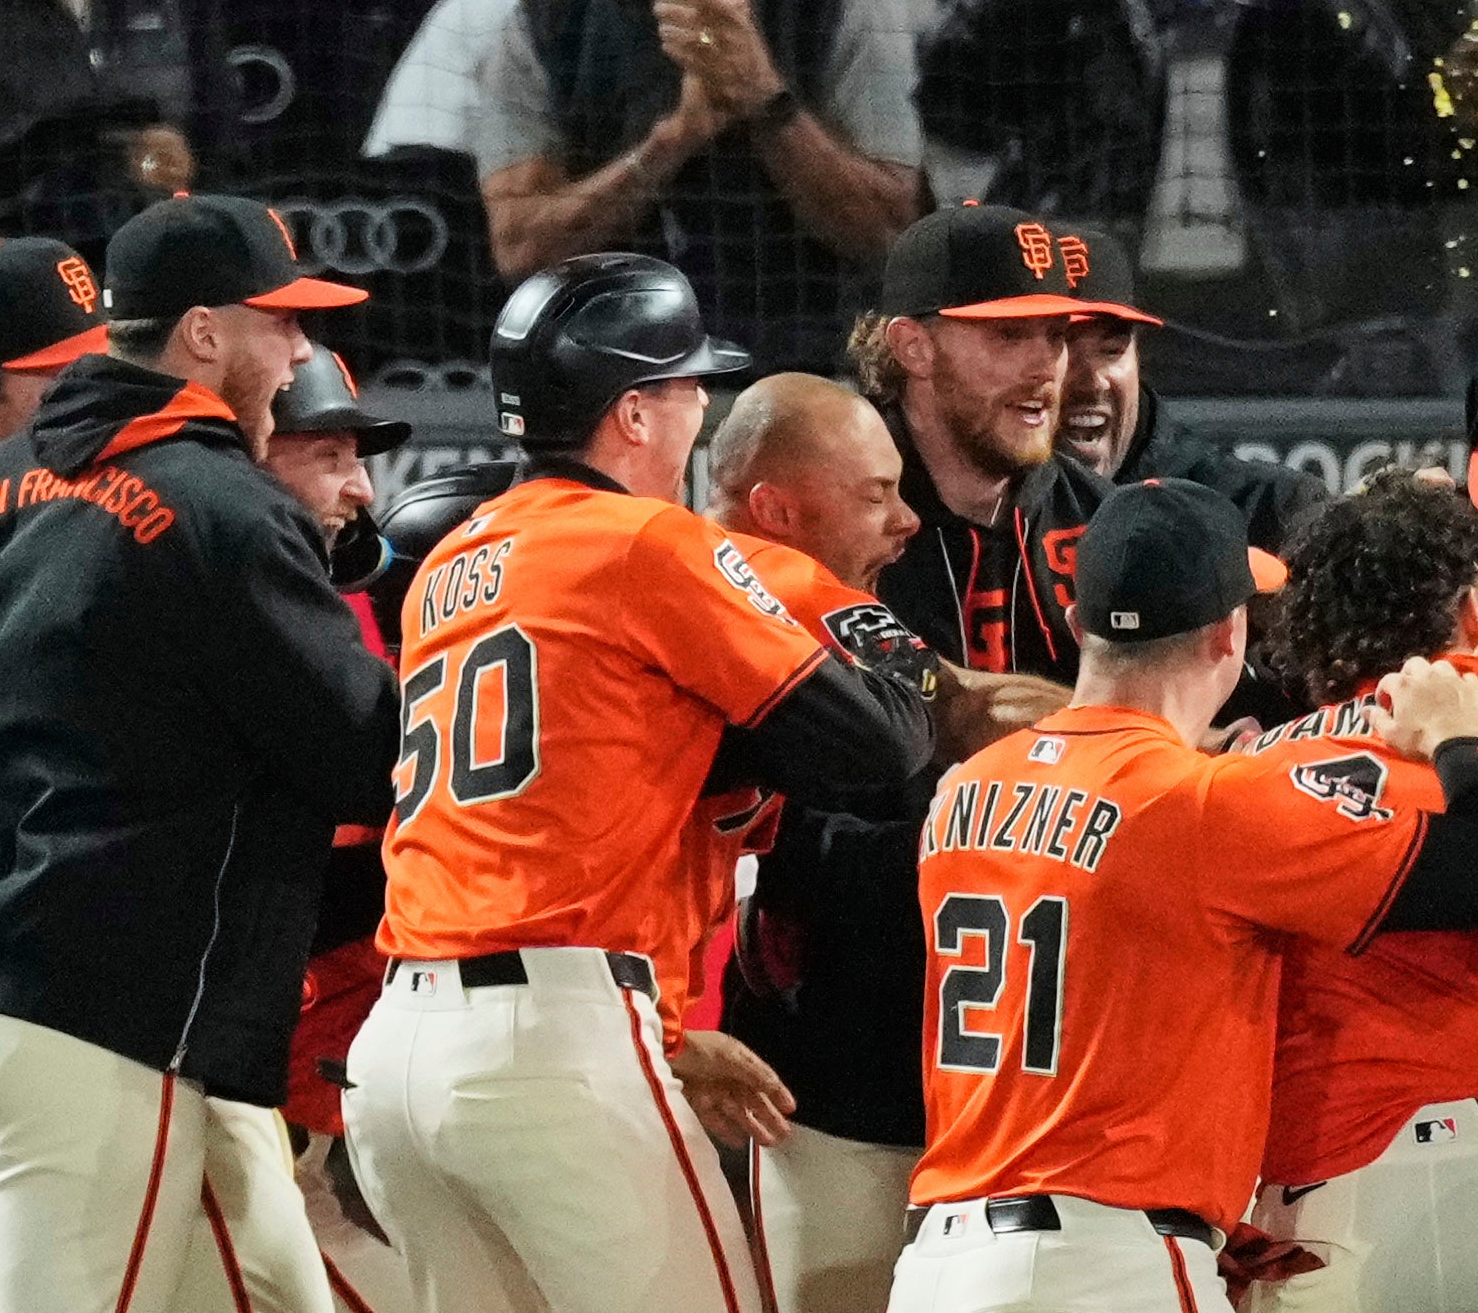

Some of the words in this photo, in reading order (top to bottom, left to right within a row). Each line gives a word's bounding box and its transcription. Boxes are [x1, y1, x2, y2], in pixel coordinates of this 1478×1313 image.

[419, 527, 515, 640] KOSS
[391, 621, 542, 838] 50
[920, 778, 1123, 874] KNIZNER
[933, 891, 1070, 1078] 21
